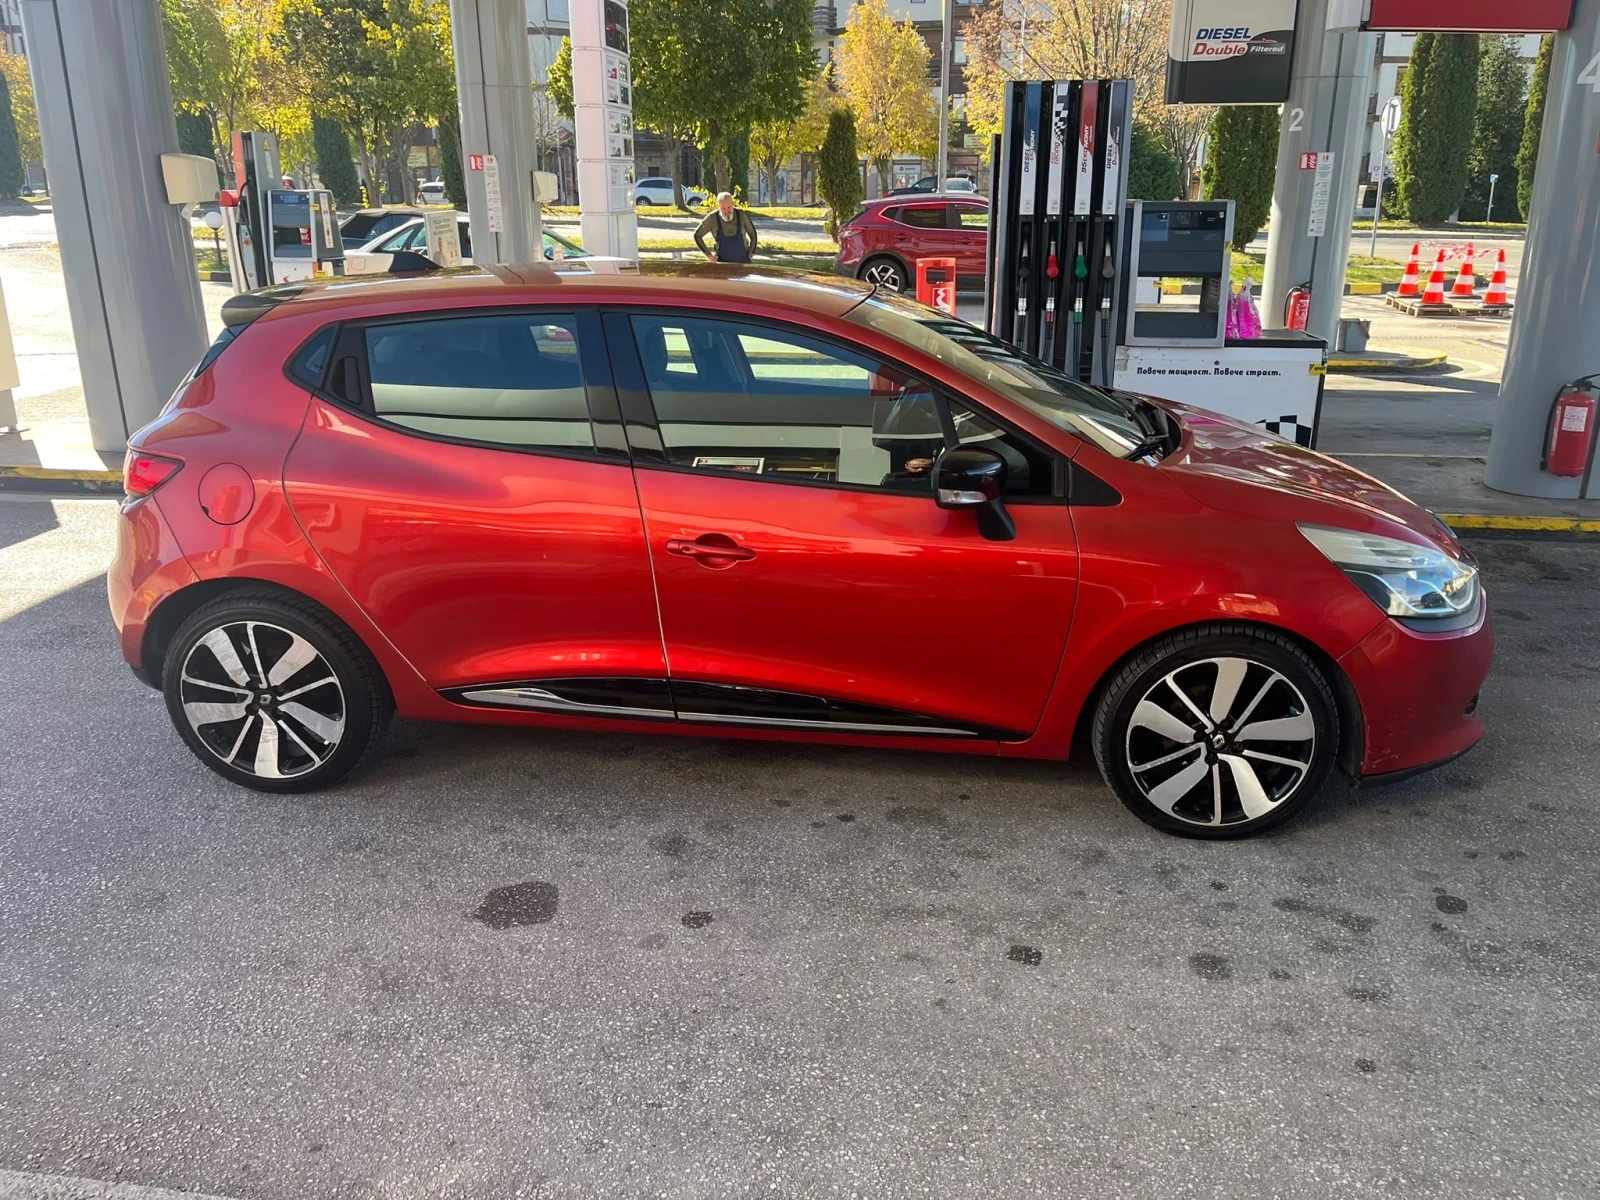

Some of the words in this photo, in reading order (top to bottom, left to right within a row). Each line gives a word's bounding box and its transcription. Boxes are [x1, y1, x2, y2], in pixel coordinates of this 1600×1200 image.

[1196, 28, 1251, 40] DIESEL
[1193, 43, 1245, 55] Double
[1577, 51, 1600, 93] 4
[1289, 107, 1304, 132] 2
[1136, 367, 1166, 375] Повече
[1214, 367, 1244, 376] Повече
